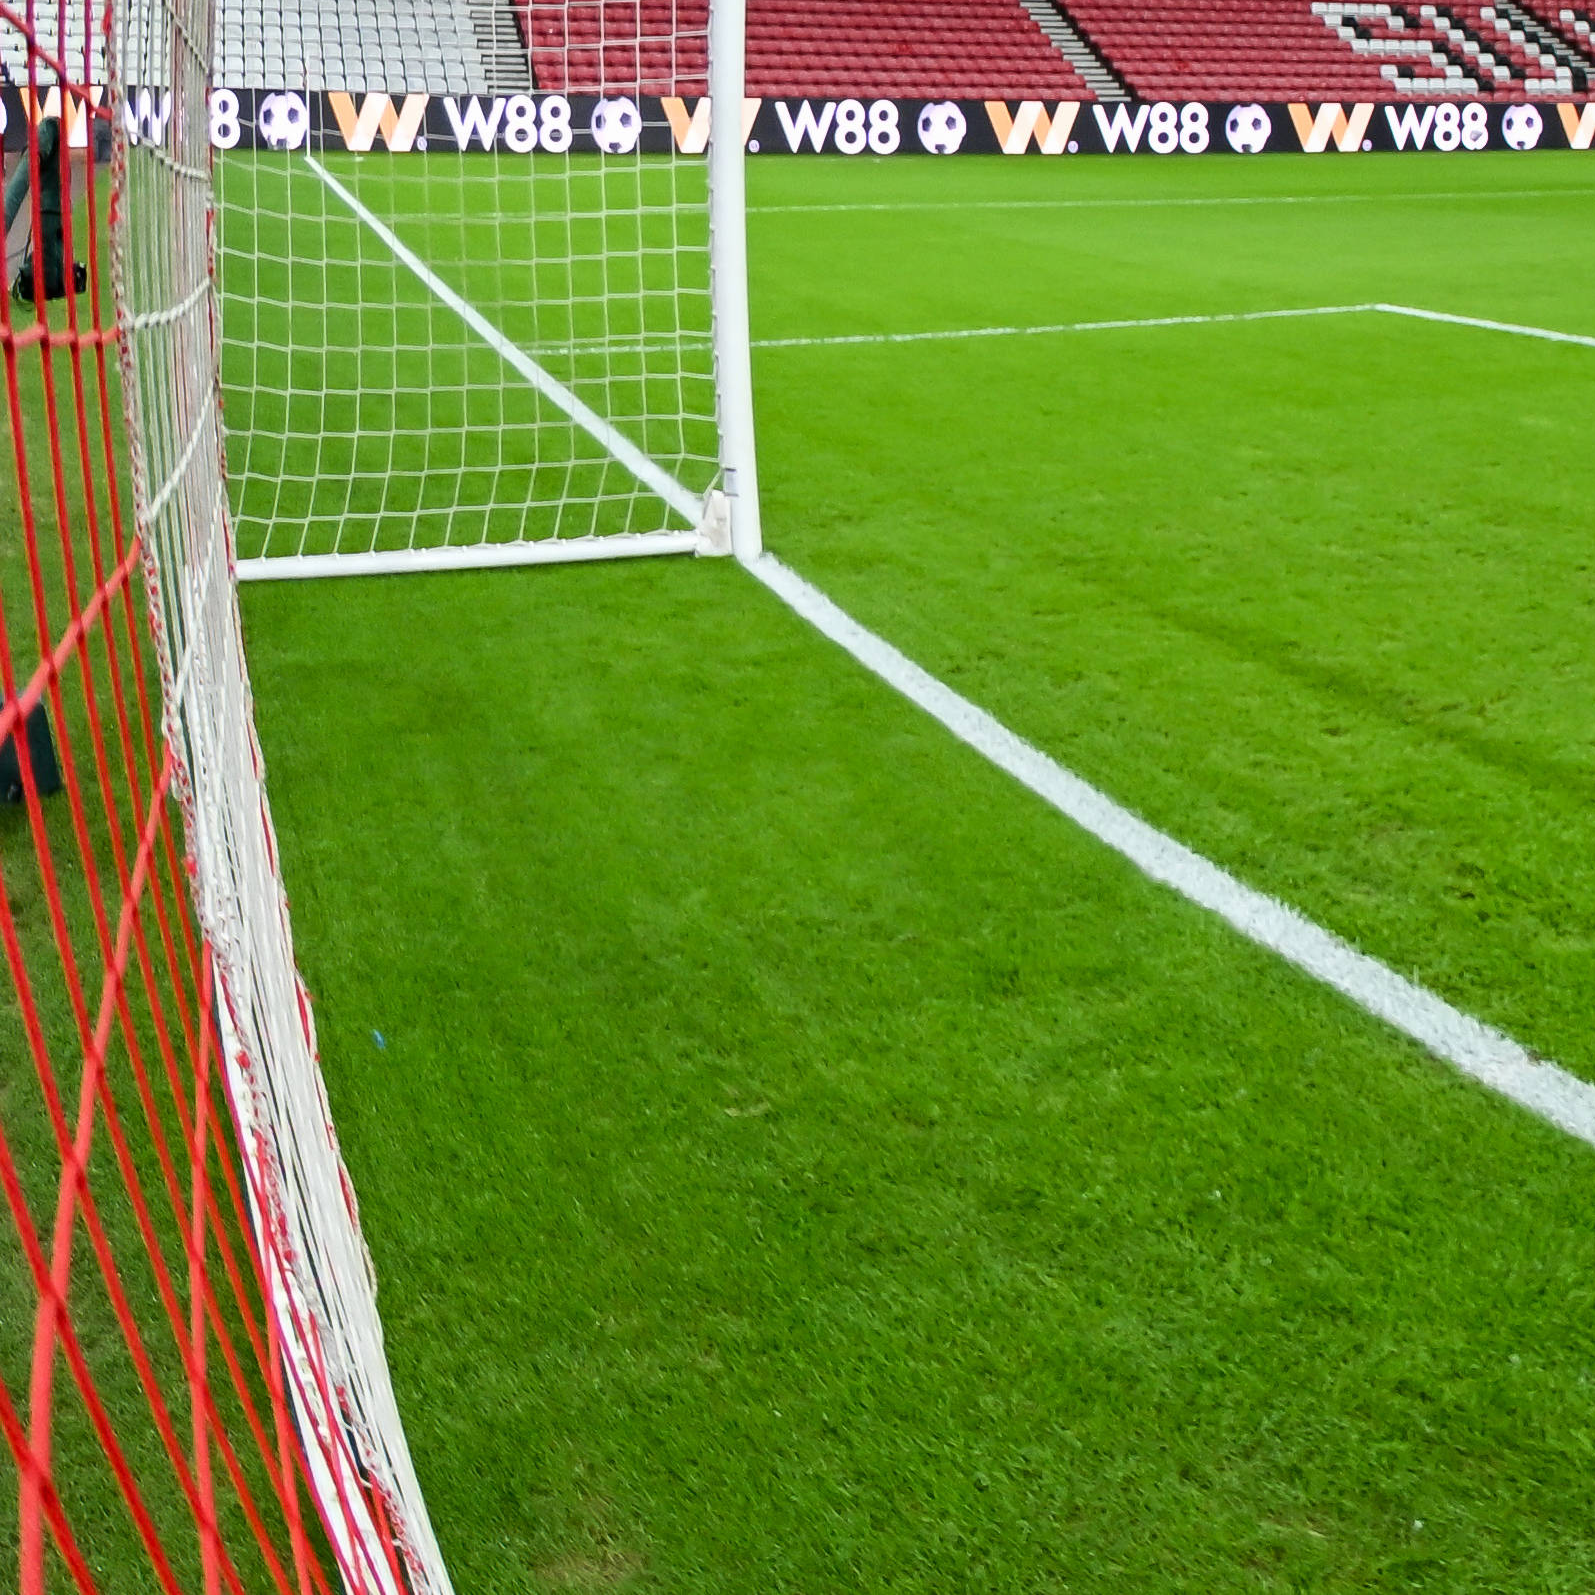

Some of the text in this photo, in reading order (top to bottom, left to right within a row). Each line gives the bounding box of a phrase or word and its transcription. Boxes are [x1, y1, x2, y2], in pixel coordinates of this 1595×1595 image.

[443, 95, 573, 153] W88
[775, 99, 900, 155] W88
[1093, 102, 1210, 154] W88
[1384, 103, 1488, 152] W88
